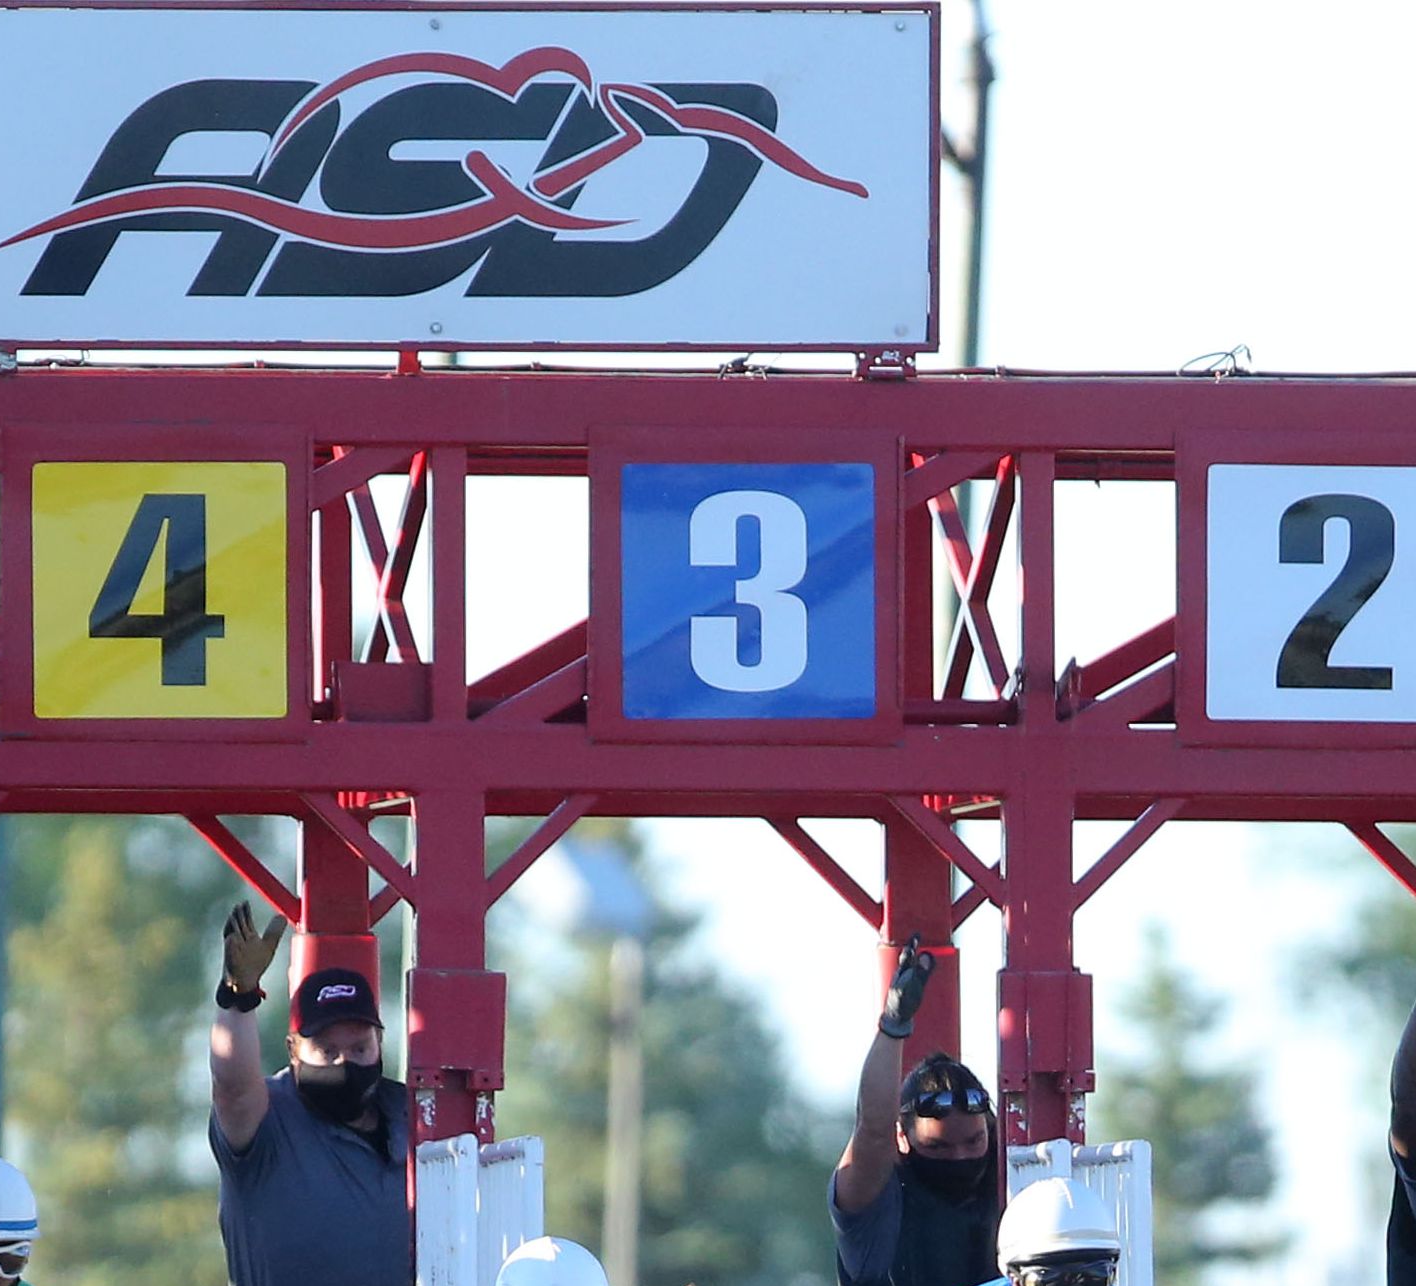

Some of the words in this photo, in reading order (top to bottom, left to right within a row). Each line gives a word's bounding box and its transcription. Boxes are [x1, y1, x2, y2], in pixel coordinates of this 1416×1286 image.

[18, 78, 779, 298] ASD
[88, 493, 226, 687] 4
[688, 490, 808, 692] 3
[1275, 493, 1396, 691] 2
